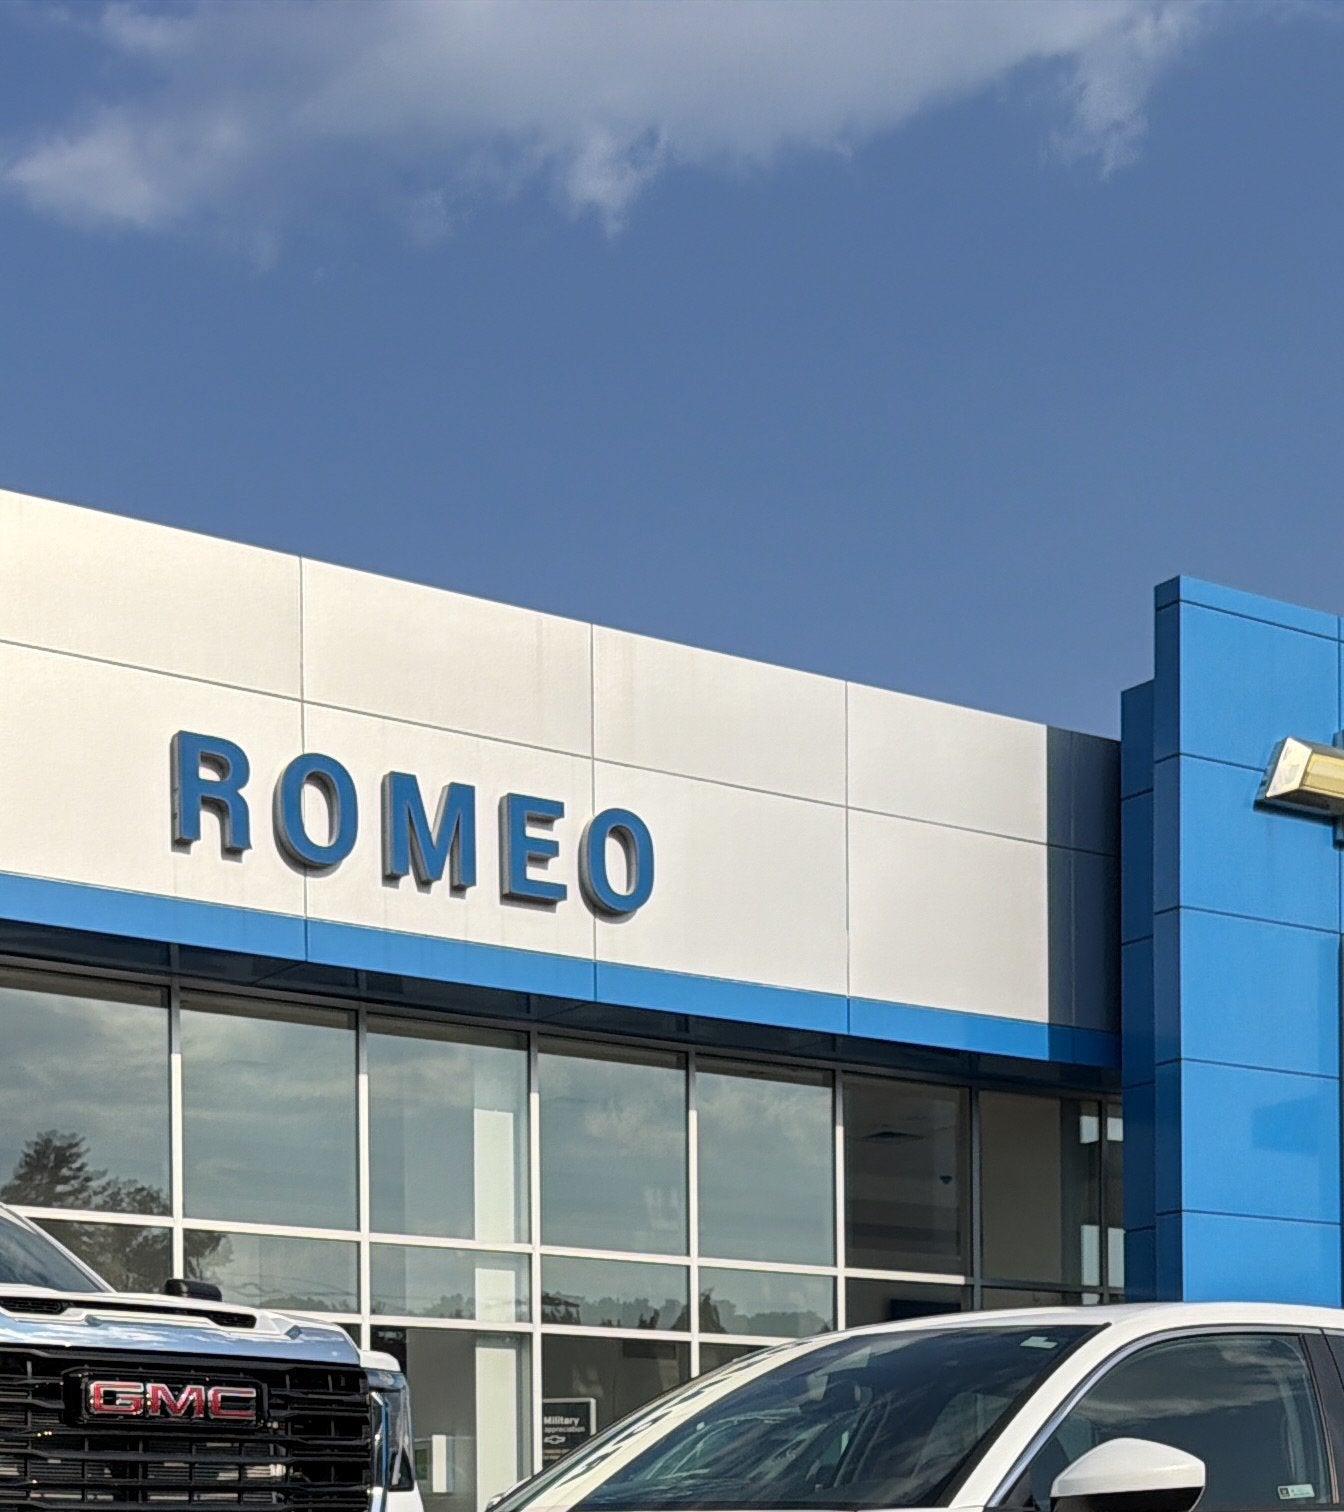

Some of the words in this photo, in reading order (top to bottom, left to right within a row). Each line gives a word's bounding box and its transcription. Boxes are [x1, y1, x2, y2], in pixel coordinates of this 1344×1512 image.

[170, 730, 654, 917] ROMEO
[92, 1381, 257, 1420] GMC
[543, 1415, 580, 1427] Military
